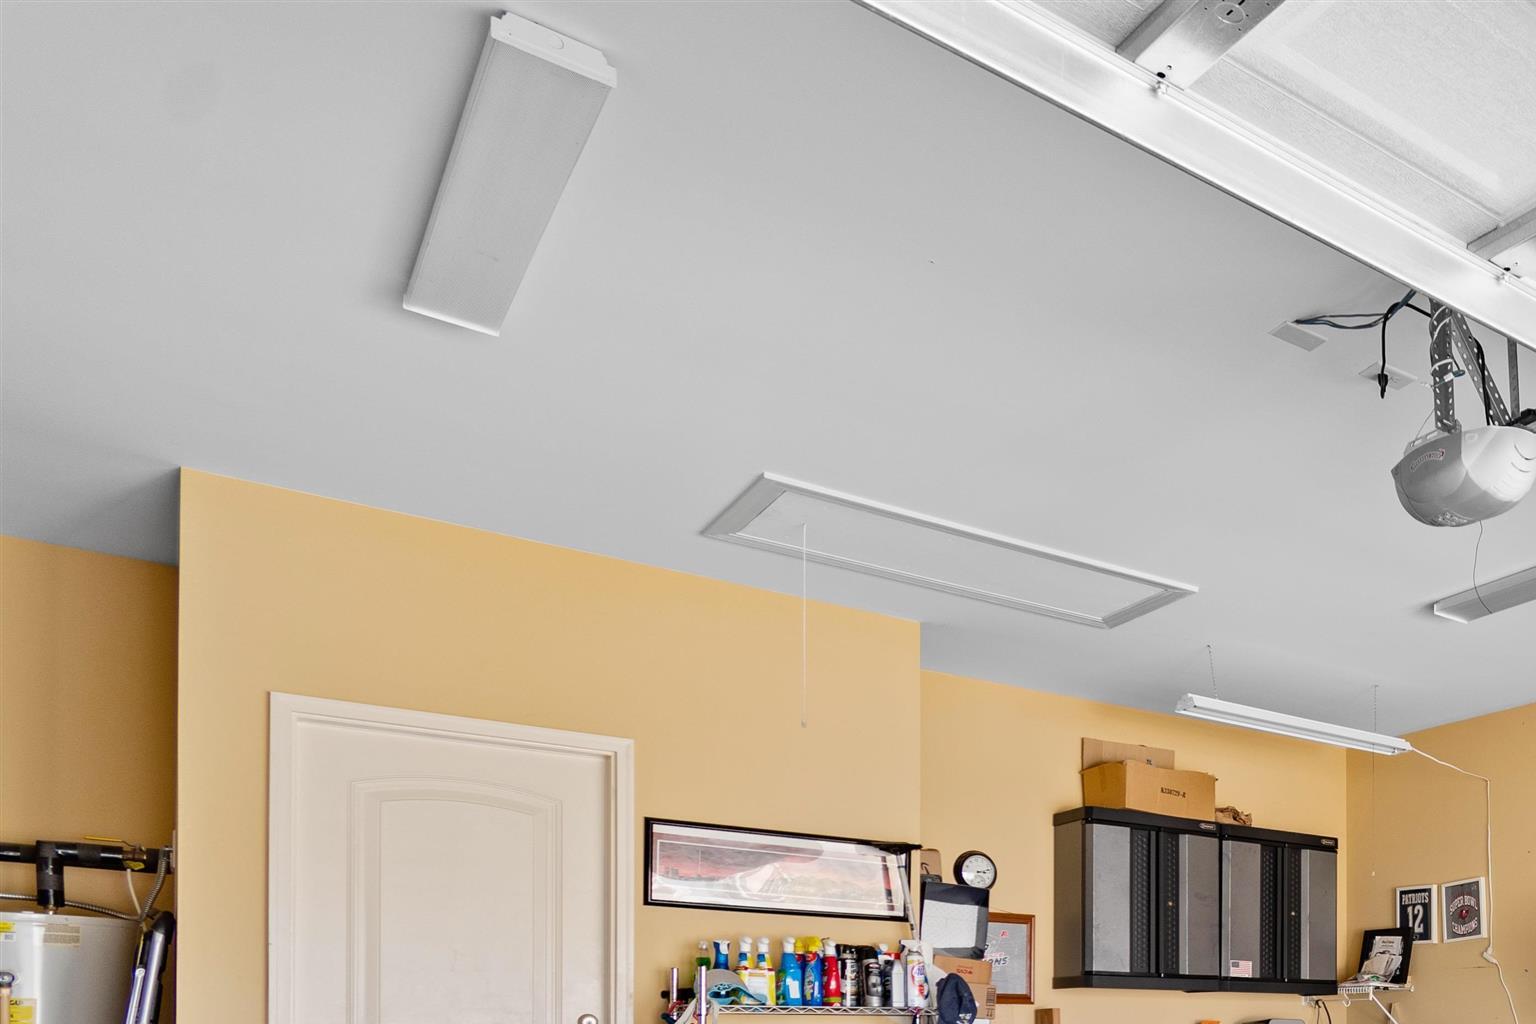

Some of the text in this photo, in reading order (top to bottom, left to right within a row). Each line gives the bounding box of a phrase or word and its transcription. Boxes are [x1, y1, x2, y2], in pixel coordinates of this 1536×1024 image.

[1401, 892, 1429, 906] PATRIOTS
[1464, 895, 1478, 911] BOWL
[1406, 905, 1424, 934] 12
